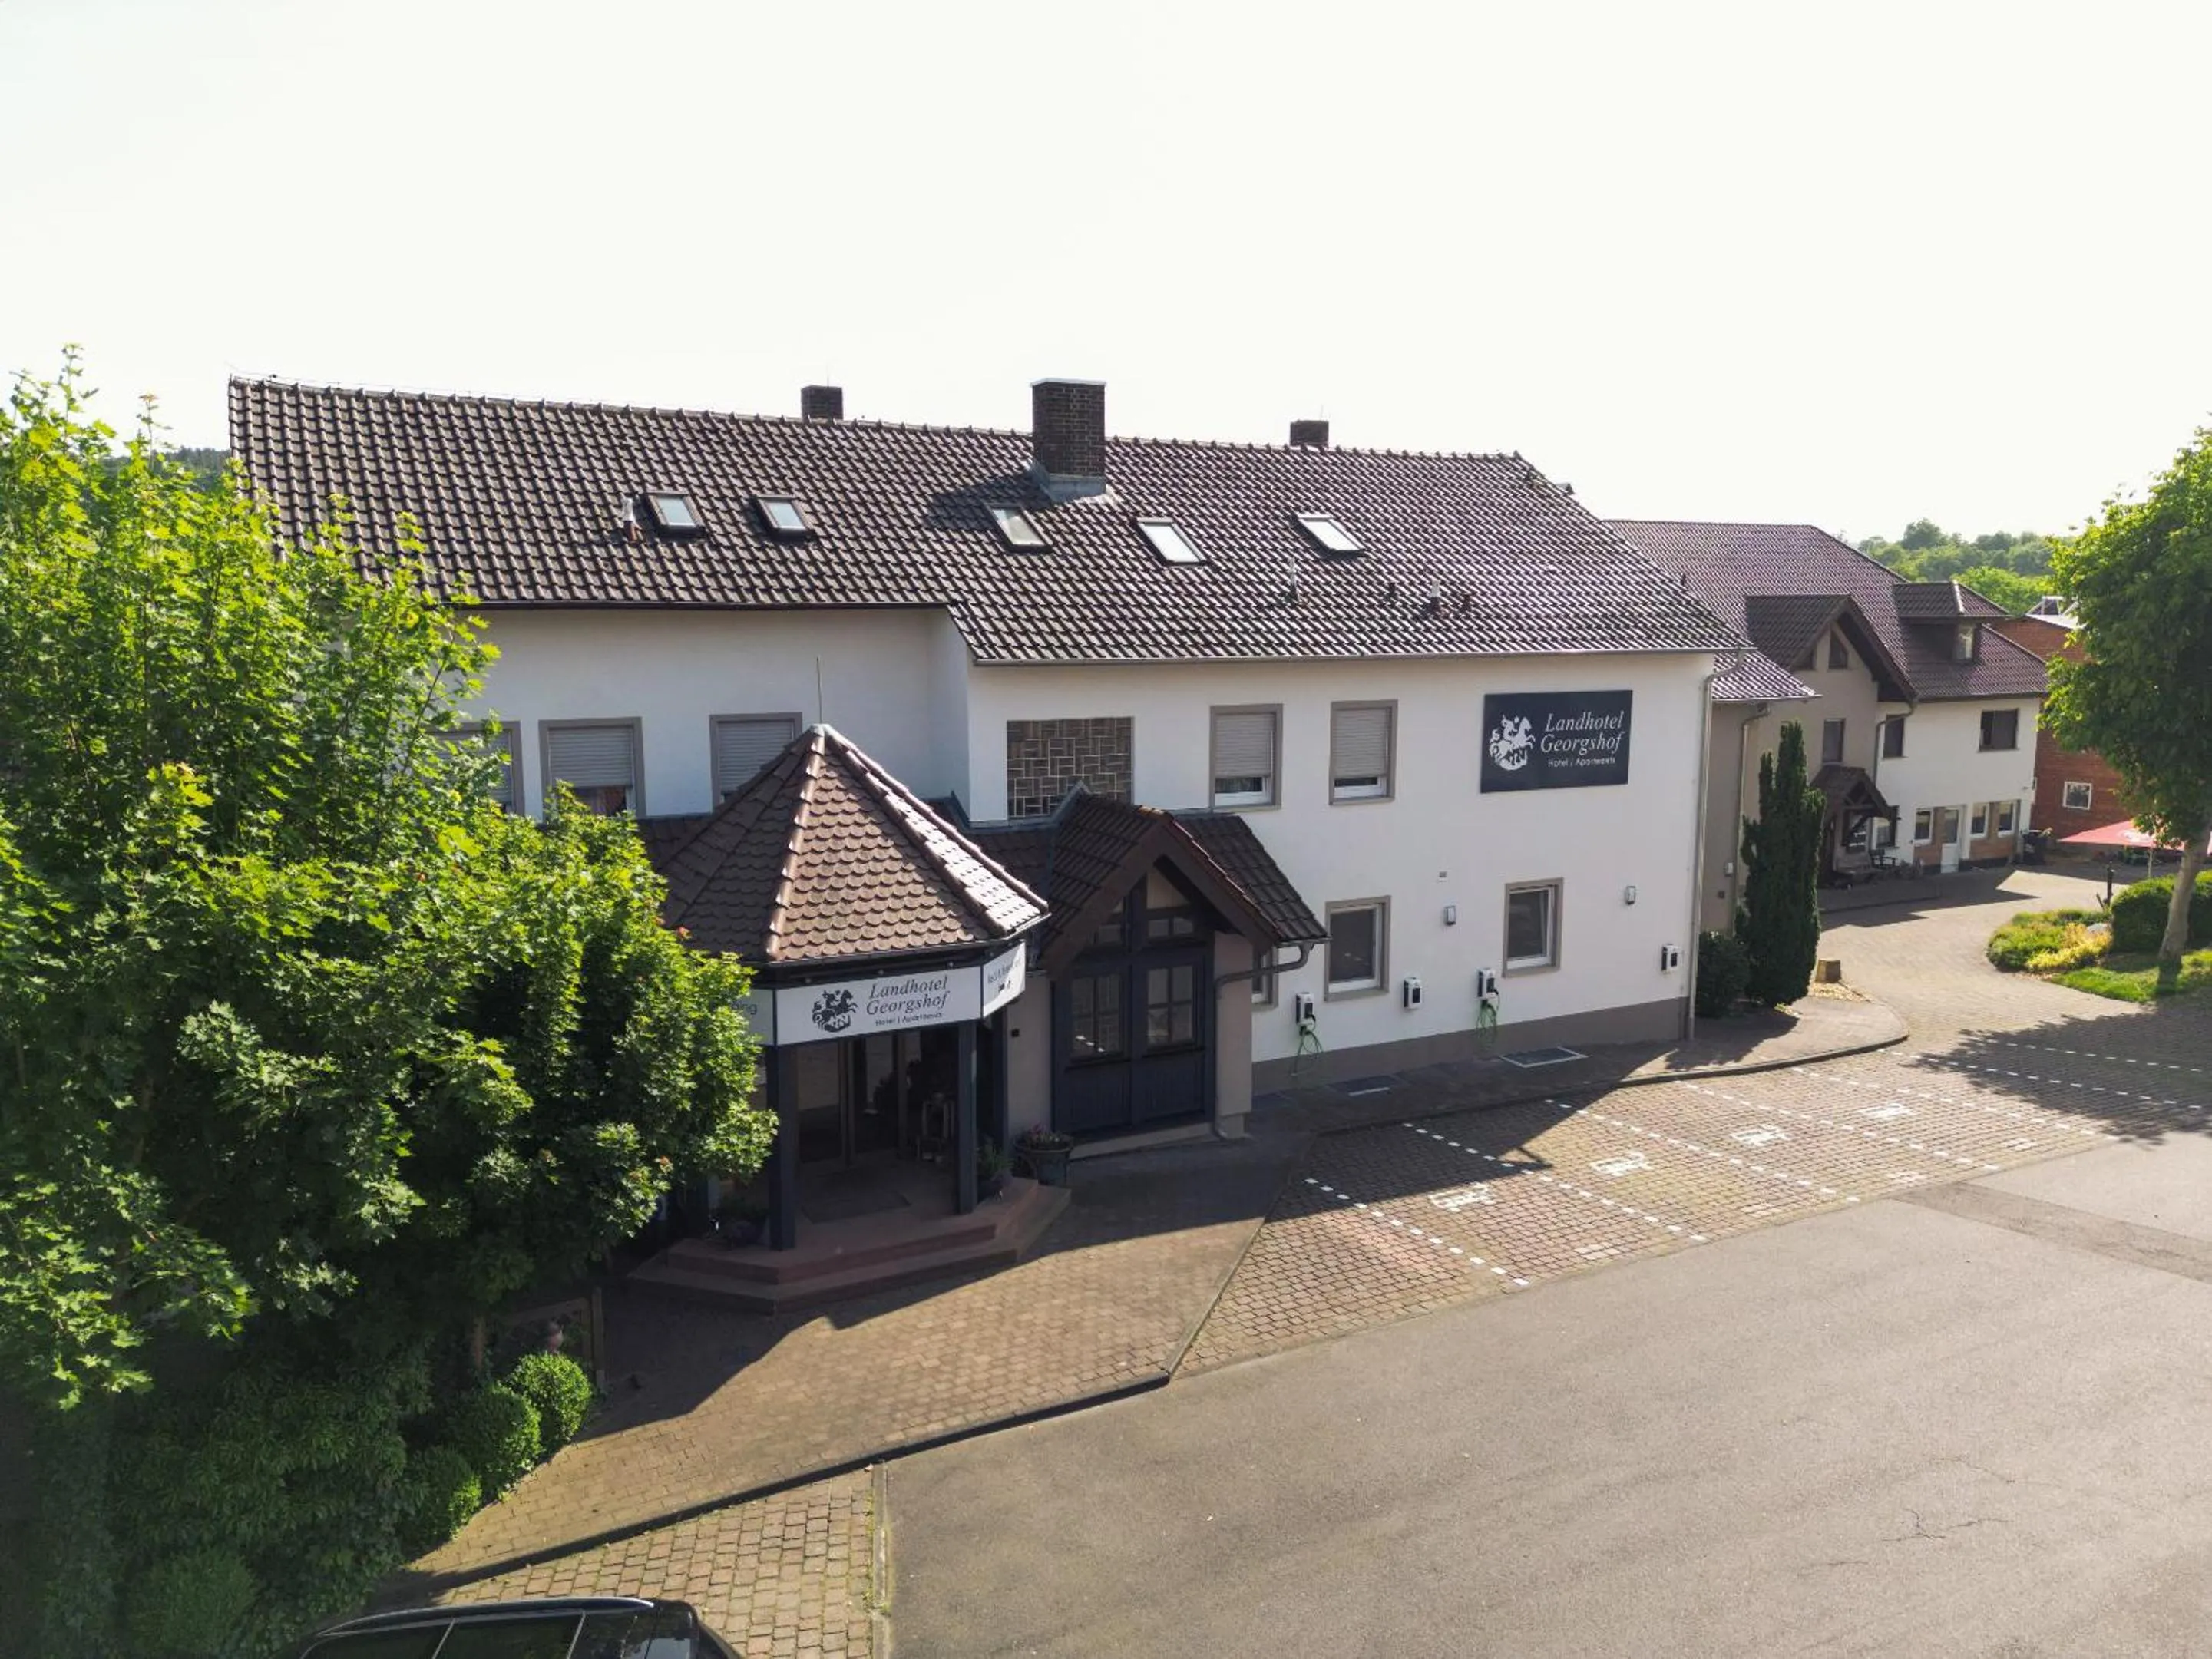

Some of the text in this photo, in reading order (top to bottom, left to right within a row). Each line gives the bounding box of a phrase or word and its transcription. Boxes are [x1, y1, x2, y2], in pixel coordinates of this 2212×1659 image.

[1545, 710, 1624, 732] Landhotel
[1540, 731, 1625, 755] Georgshof
[869, 975, 947, 999] Landhotel
[866, 990, 951, 1015] Georgshof
